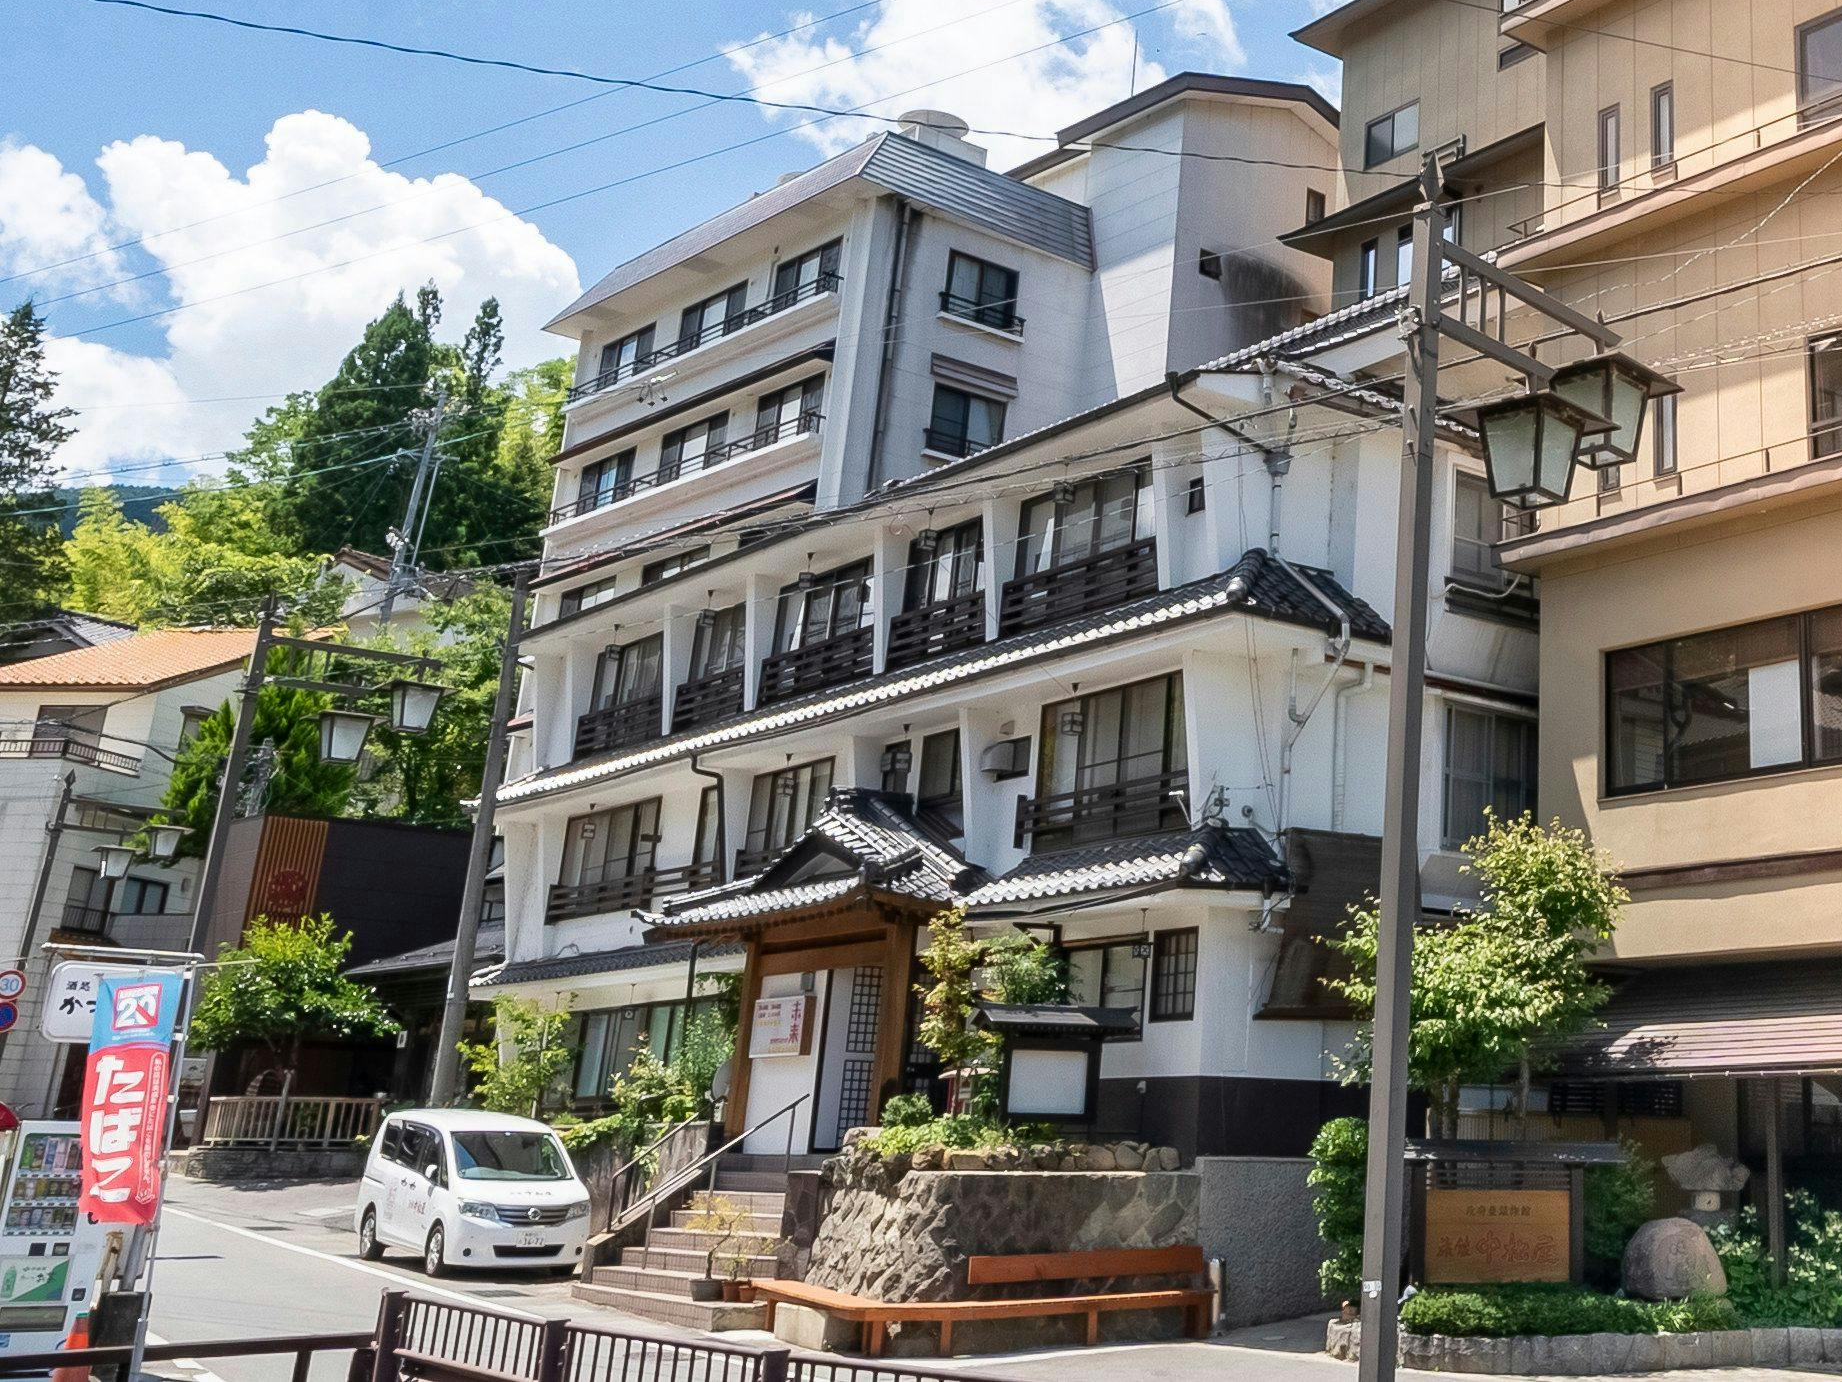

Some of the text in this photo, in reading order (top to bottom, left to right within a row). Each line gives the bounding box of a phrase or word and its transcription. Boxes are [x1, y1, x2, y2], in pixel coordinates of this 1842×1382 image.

[1, 978, 20, 992] 30
[89, 1054, 146, 1203] たばこ
